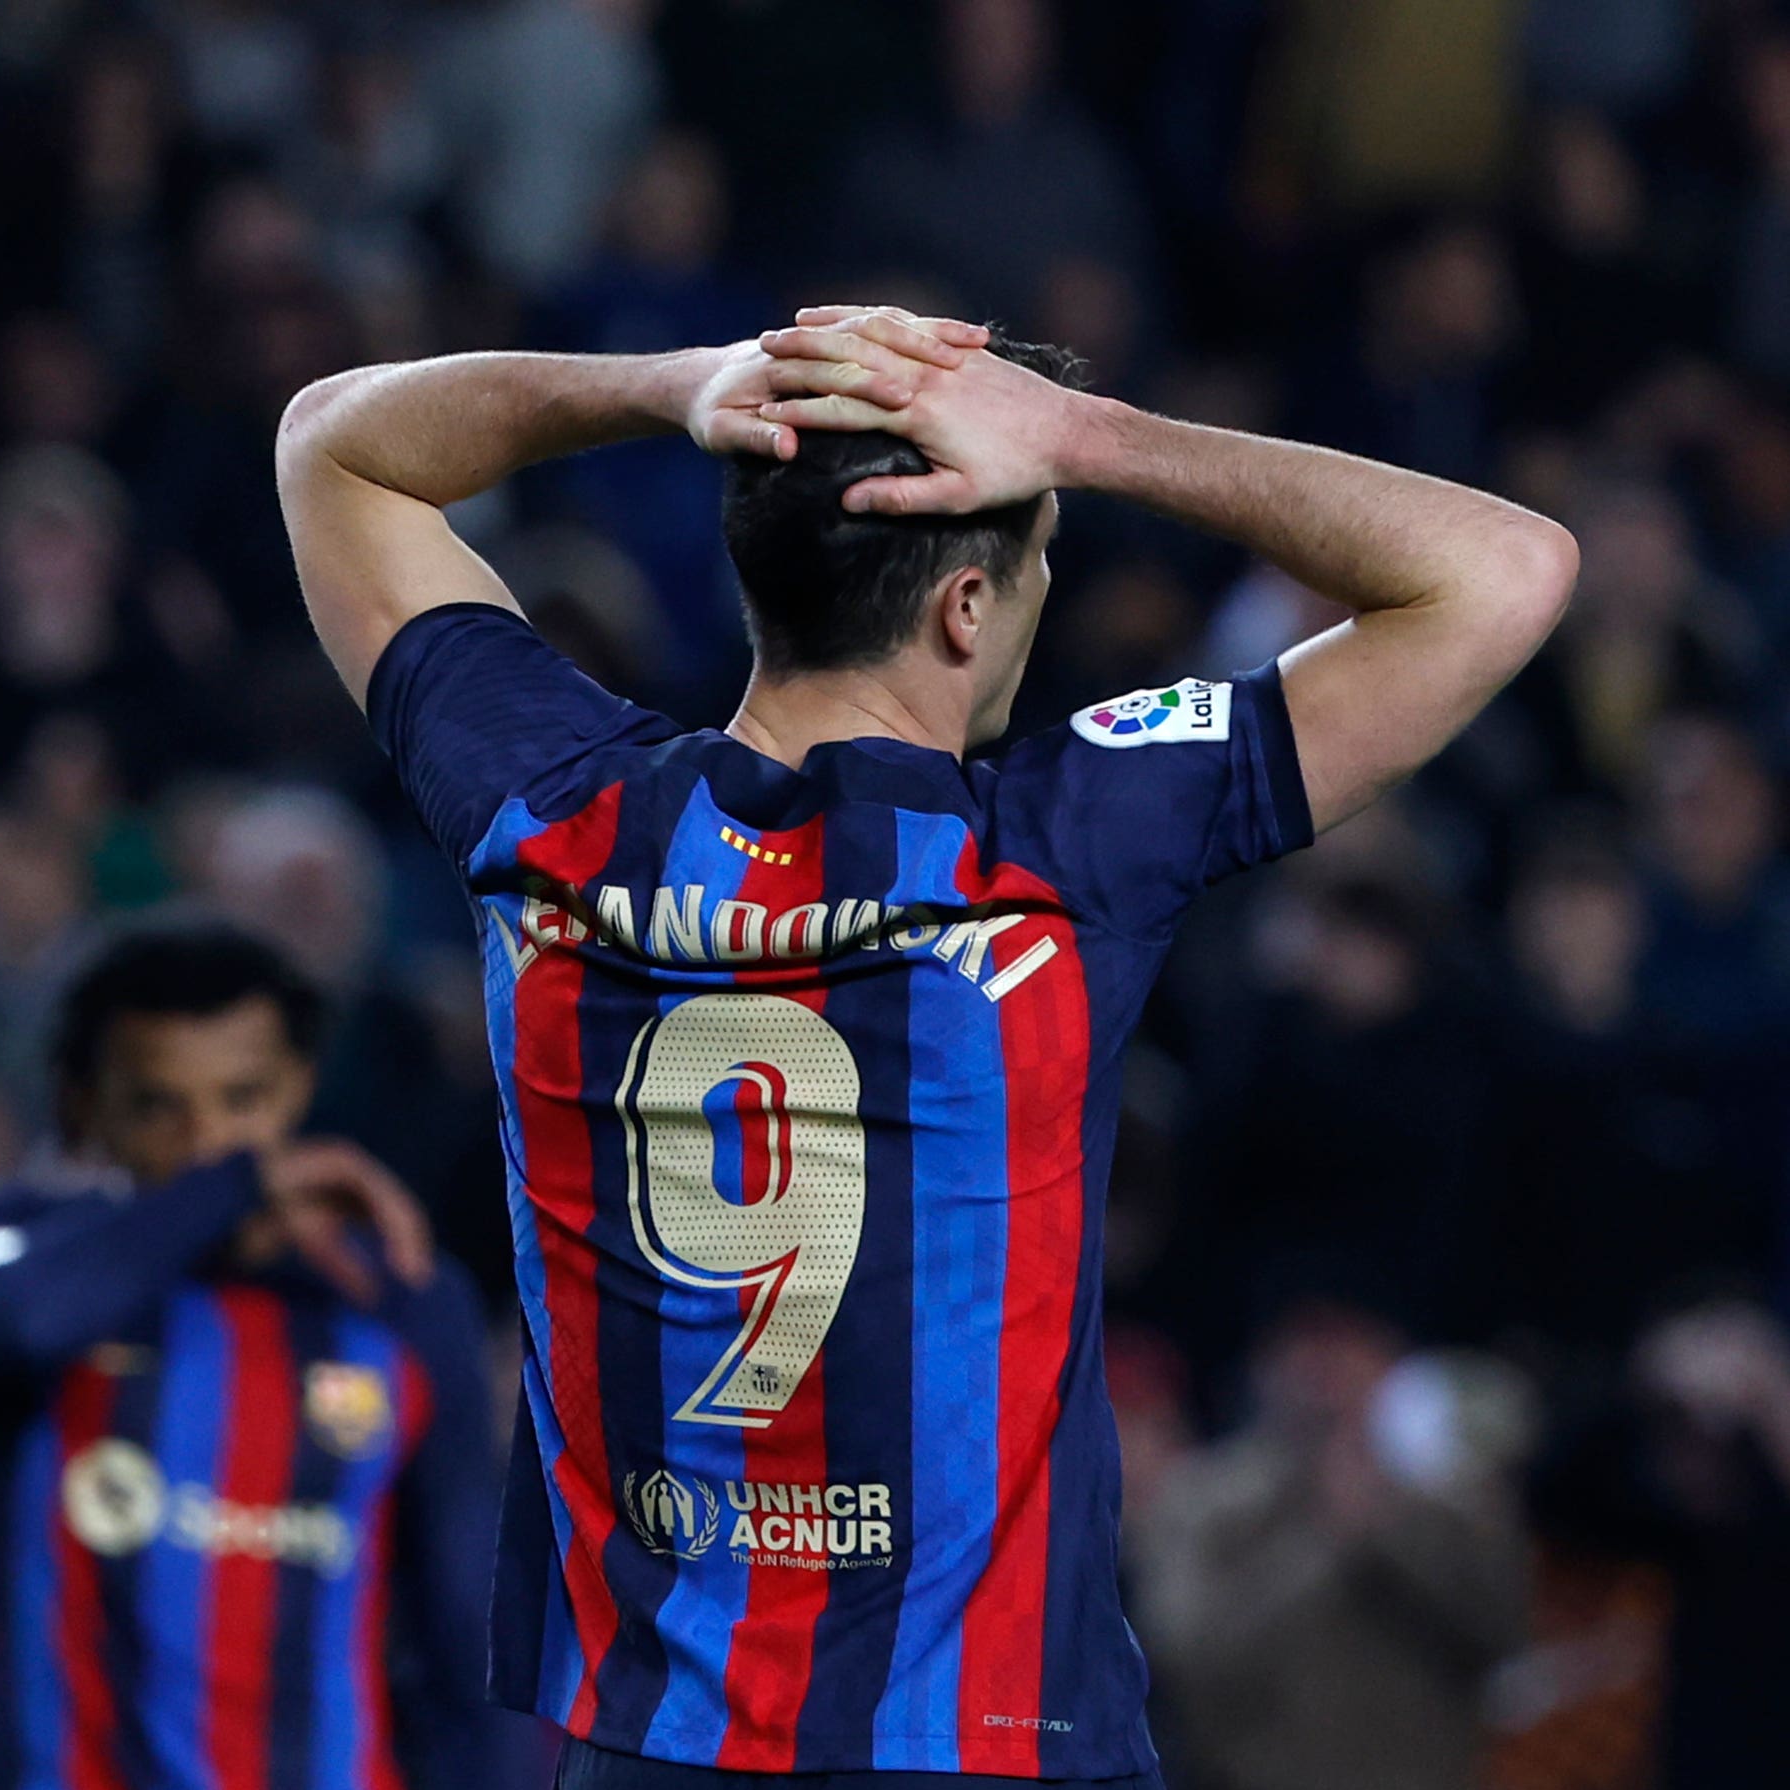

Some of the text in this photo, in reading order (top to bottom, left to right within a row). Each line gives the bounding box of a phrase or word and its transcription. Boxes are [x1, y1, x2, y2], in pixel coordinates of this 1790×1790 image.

[614, 993, 867, 1429] 9
[725, 1480, 892, 1517] UNHCR
[728, 1514, 892, 1555] ACNUR
[730, 1551, 755, 1565] The
[757, 1554, 777, 1566] UN
[780, 1555, 836, 1571] Refugee
